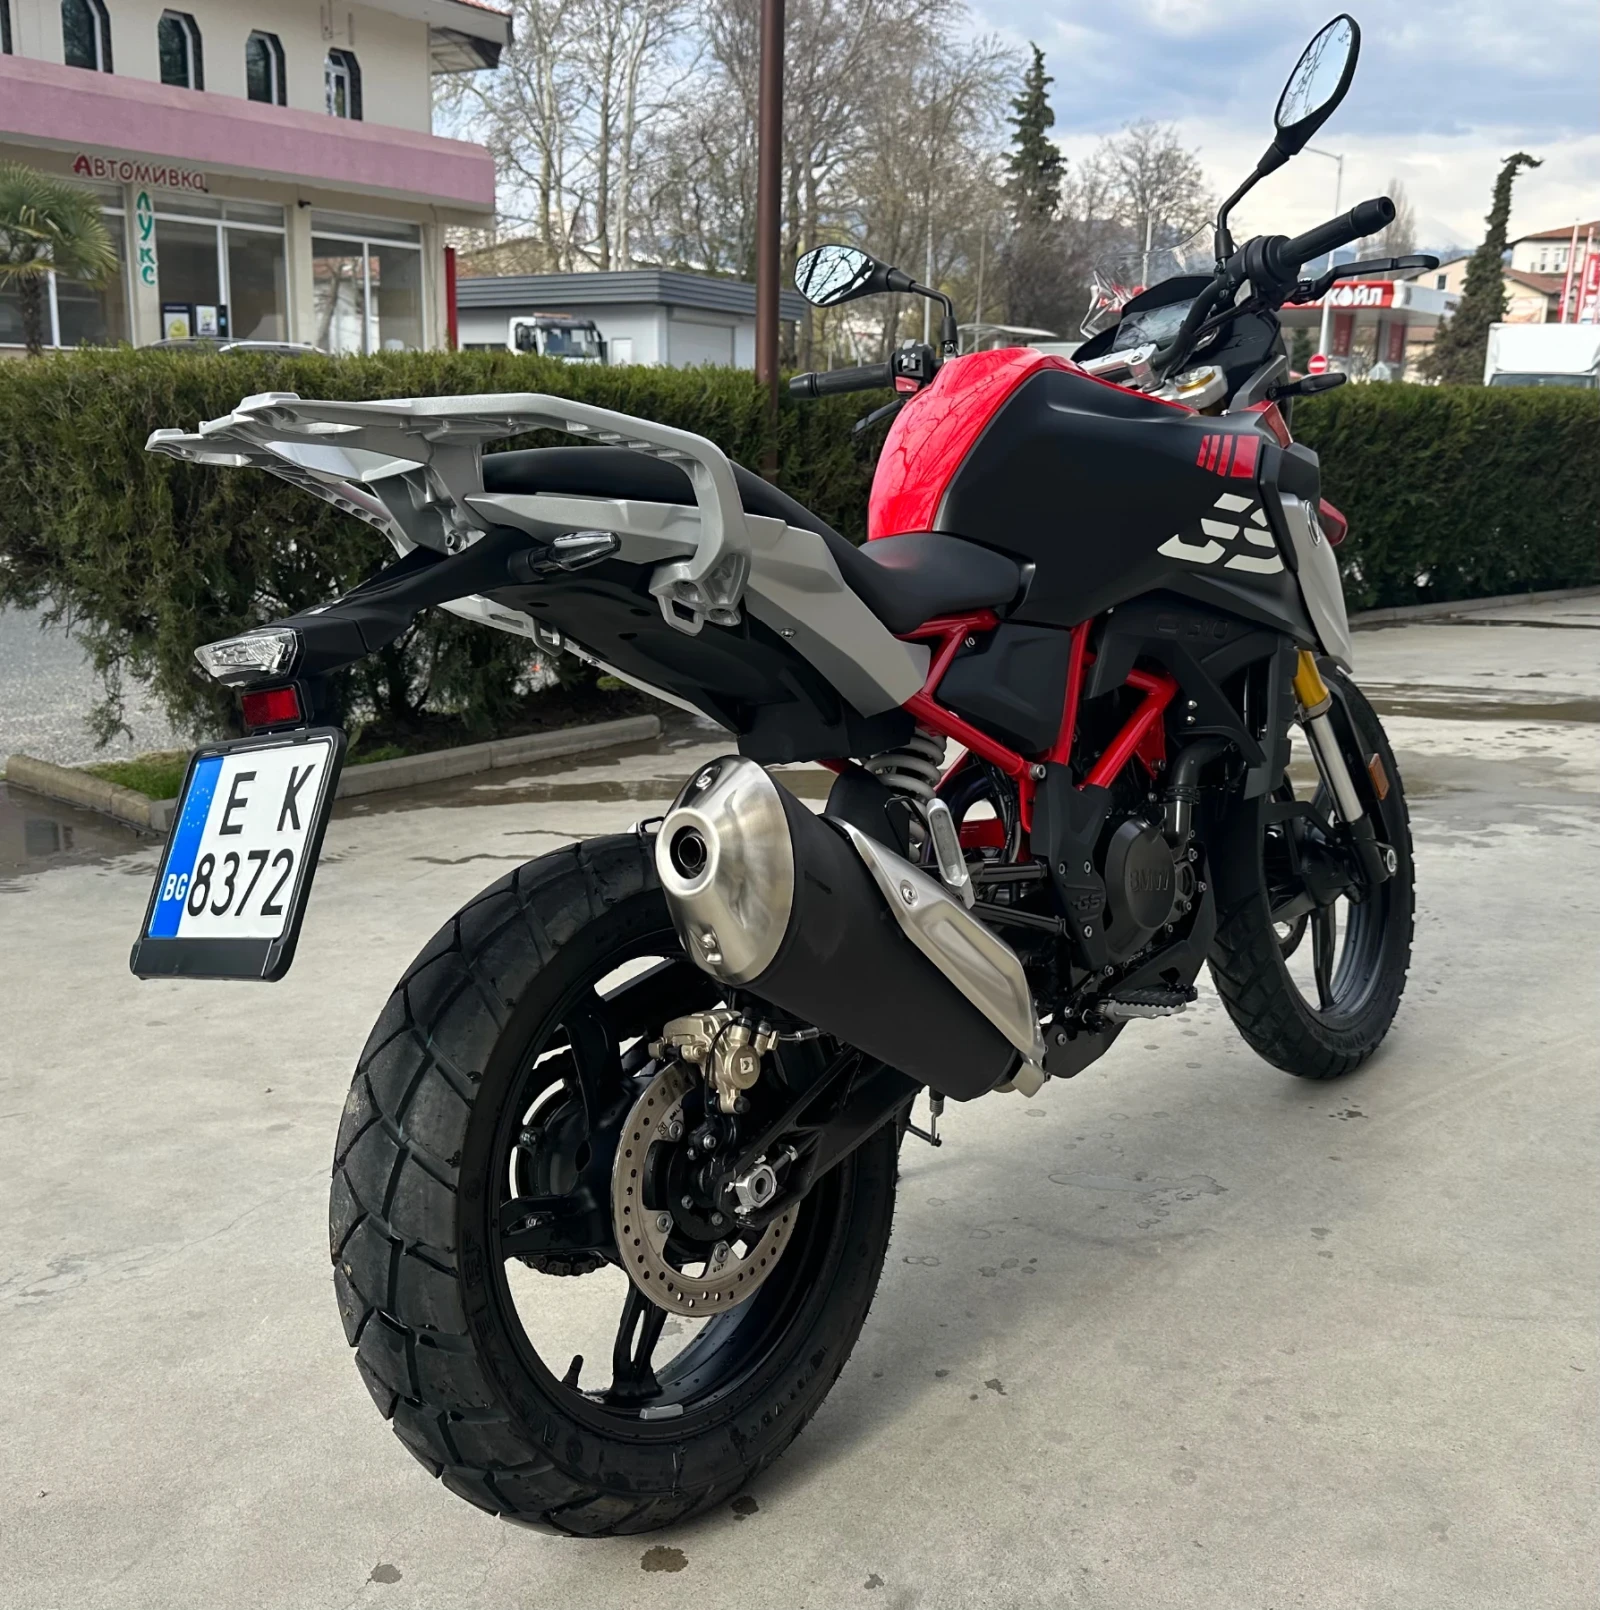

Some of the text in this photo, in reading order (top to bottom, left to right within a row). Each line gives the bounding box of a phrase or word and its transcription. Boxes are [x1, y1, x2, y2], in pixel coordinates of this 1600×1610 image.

[1306, 284, 1384, 307] КОЙЛ
[162, 848, 295, 917] BG 8372
[1129, 867, 1170, 892] BMW
